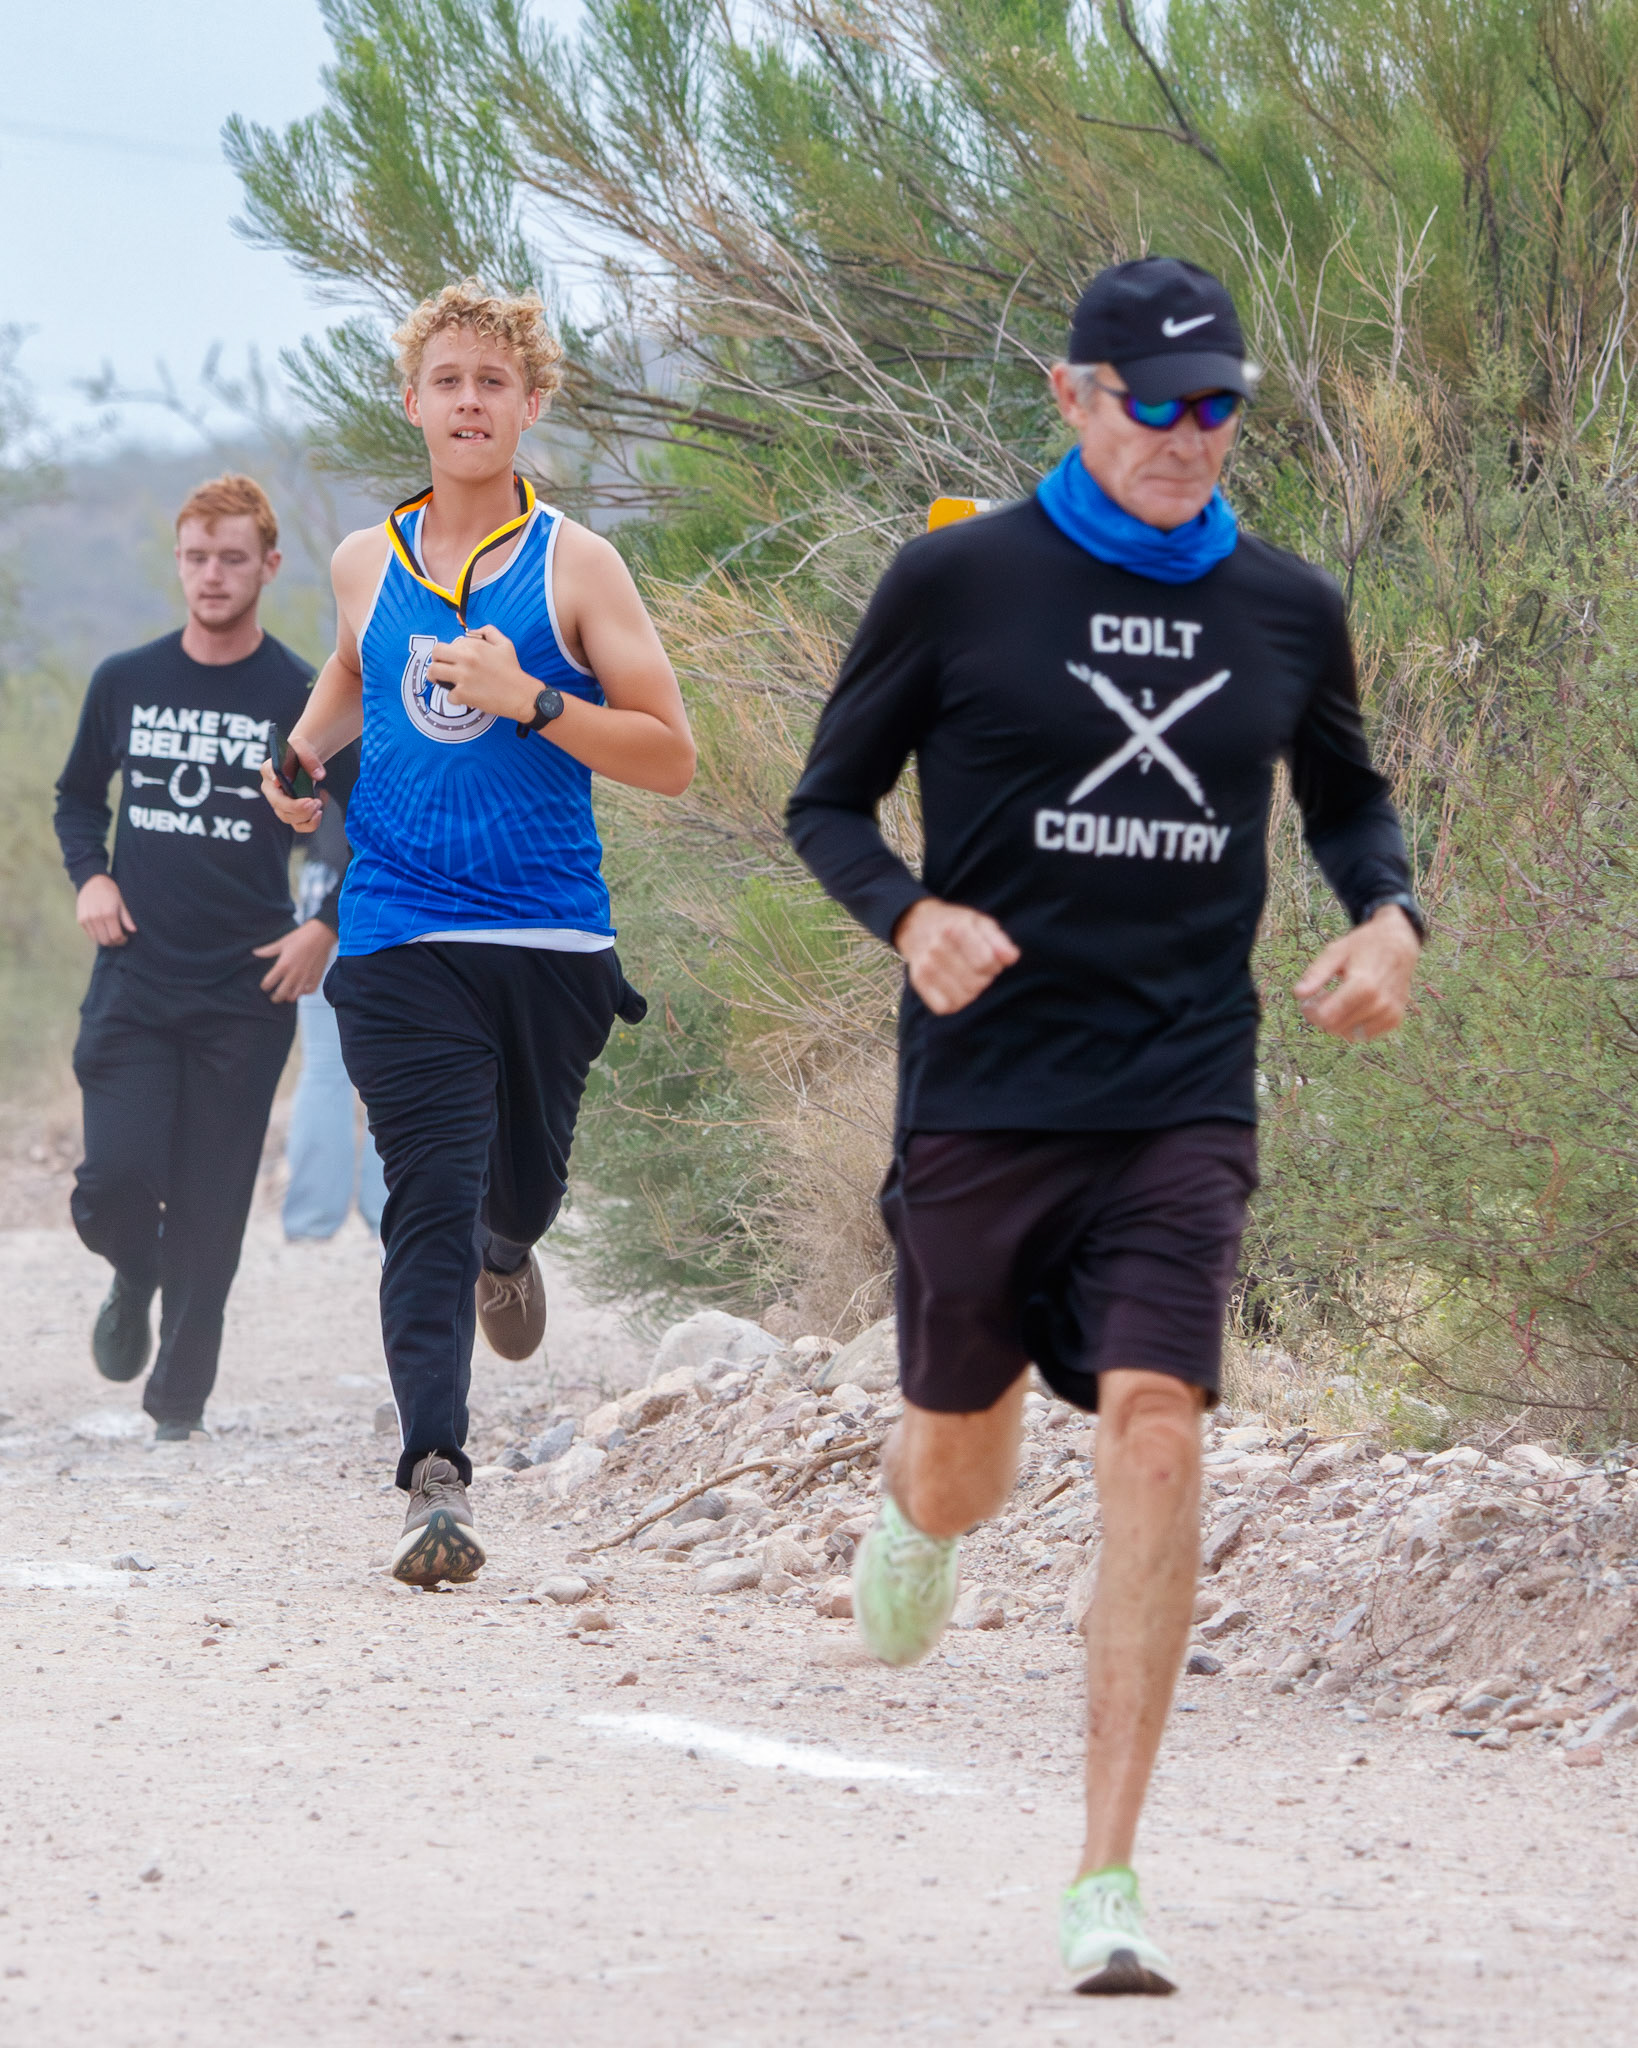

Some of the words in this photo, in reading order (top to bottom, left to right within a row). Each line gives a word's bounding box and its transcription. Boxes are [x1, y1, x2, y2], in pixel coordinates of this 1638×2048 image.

[1090, 614, 1203, 660] COLT
[1141, 688, 1156, 710] 1
[129, 728, 267, 771] BELIEVE
[128, 804, 207, 836] BUENA
[210, 815, 252, 842] XC
[1035, 808, 1231, 863] COUNTRY
